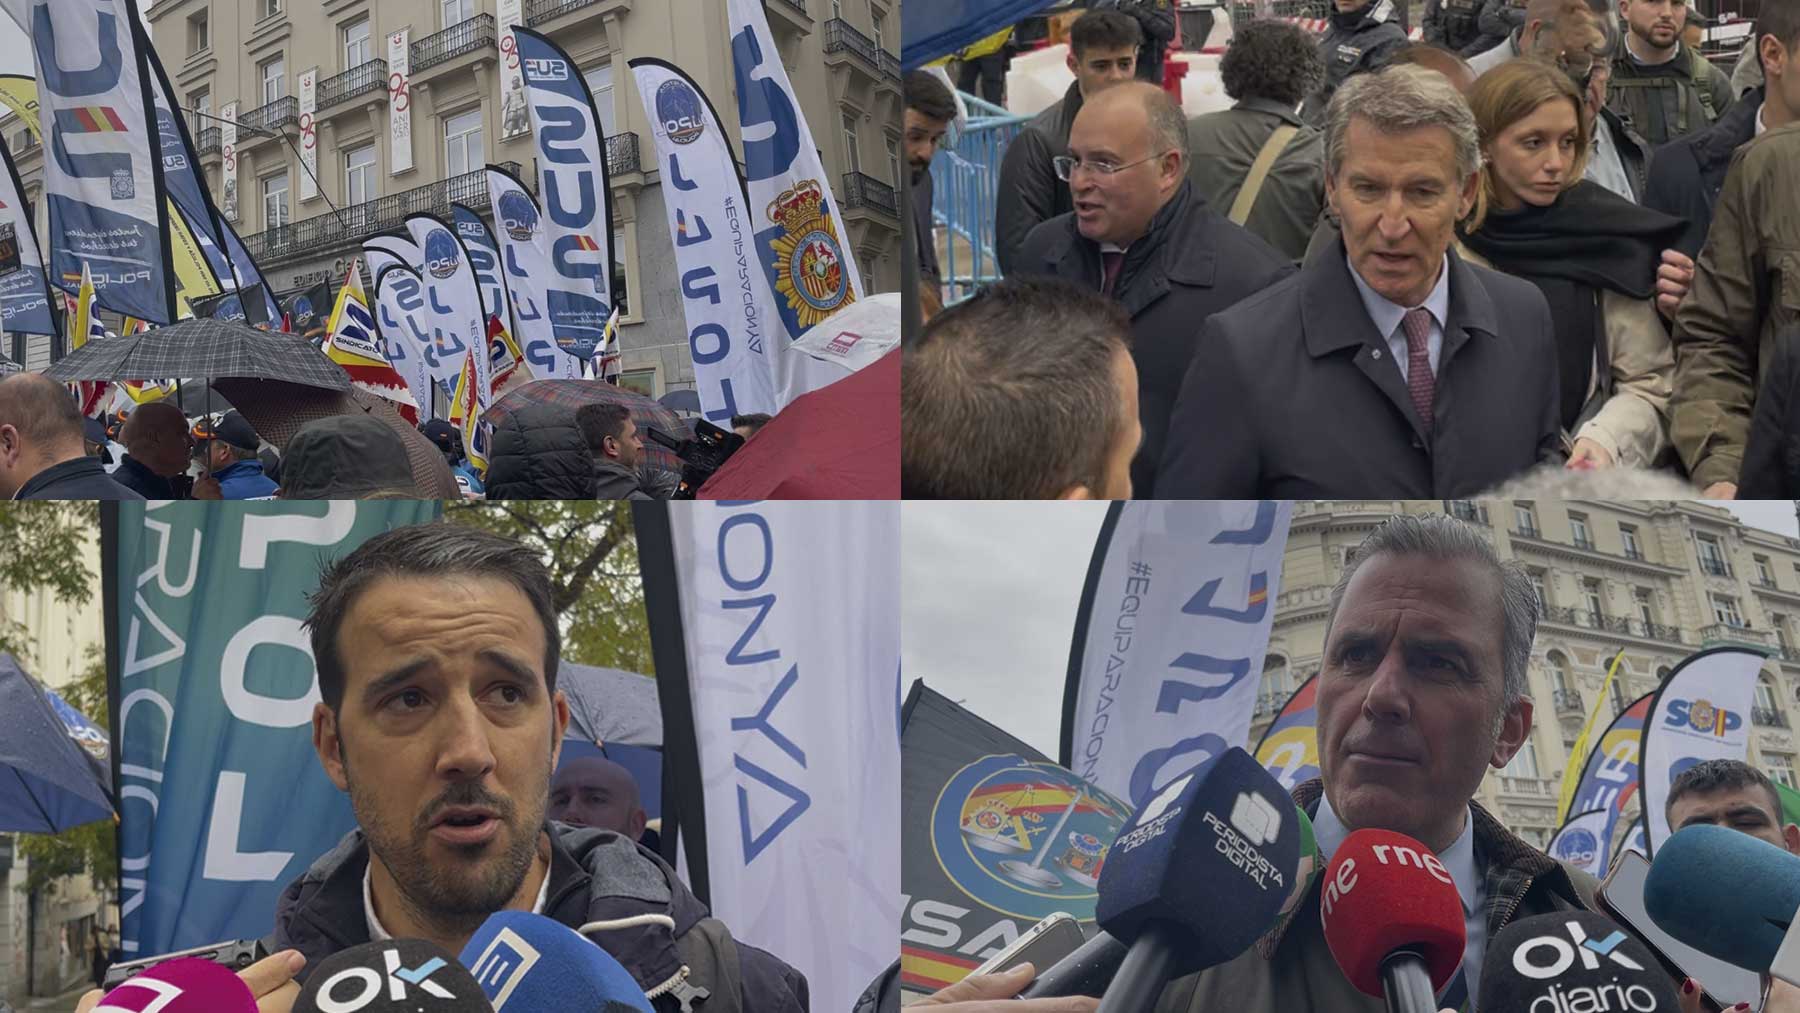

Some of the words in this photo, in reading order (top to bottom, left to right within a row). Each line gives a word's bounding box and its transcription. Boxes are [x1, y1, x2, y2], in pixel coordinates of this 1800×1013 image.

[388, 72, 409, 112] 95
[300, 113, 316, 150] 95
[1202, 811, 1284, 888] PERIODISTA
[1214, 838, 1268, 891] DIGITAL
[1371, 844, 1452, 884] rne
[1529, 976, 1657, 1013] diario
